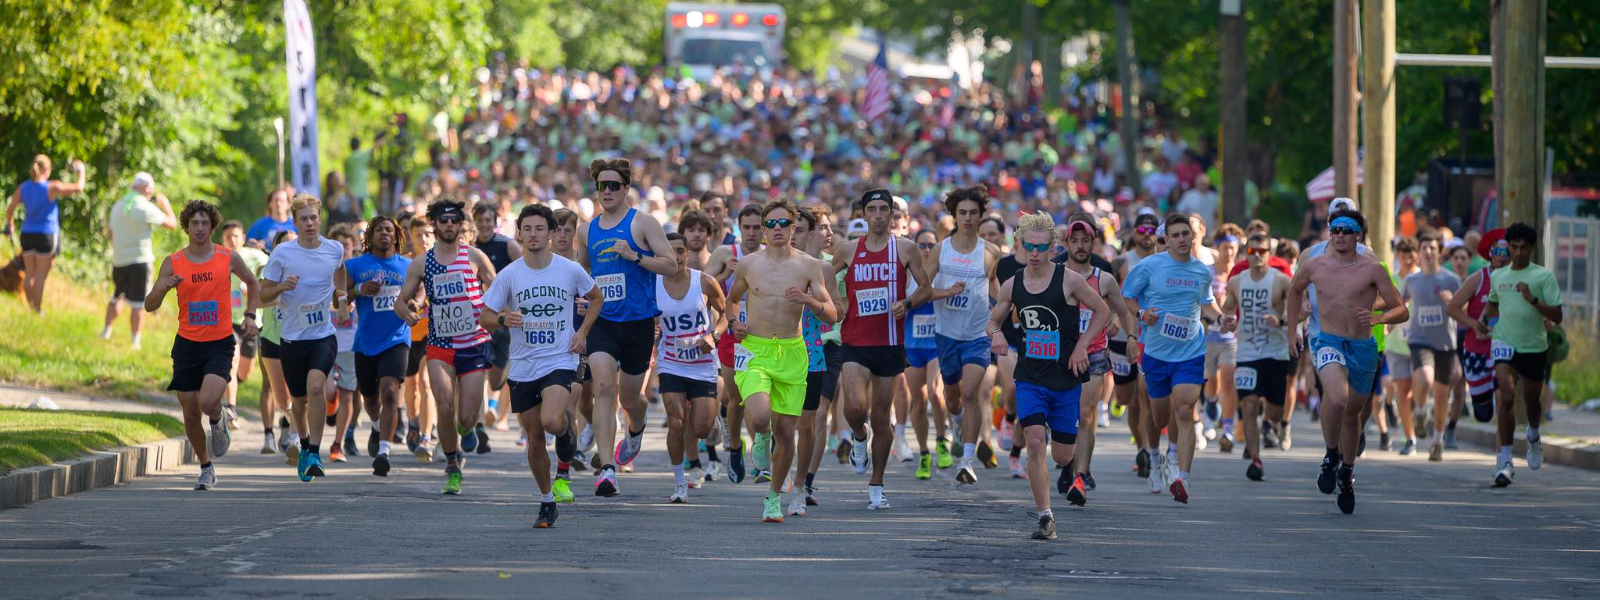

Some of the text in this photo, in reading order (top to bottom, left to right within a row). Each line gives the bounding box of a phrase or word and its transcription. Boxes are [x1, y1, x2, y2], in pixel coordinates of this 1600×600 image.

[192, 272, 213, 284] BNSC
[854, 262, 897, 282] NOTCH
[435, 280, 463, 297] 2166
[516, 286, 567, 303] TACONIC
[601, 285, 623, 300] 769
[376, 296, 398, 310] 223
[859, 298, 888, 314] 1929
[190, 310, 219, 323] 2565
[306, 311, 323, 324] 114
[441, 306, 463, 320] NO
[1241, 289, 1254, 345] EQUITY
[437, 318, 473, 334] KINGS
[663, 311, 706, 332] USA
[524, 331, 555, 345] 1663
[1163, 323, 1189, 339] 1603
[1028, 340, 1057, 357] 2516
[1492, 347, 1513, 357] 031
[1321, 353, 1341, 363] 974
